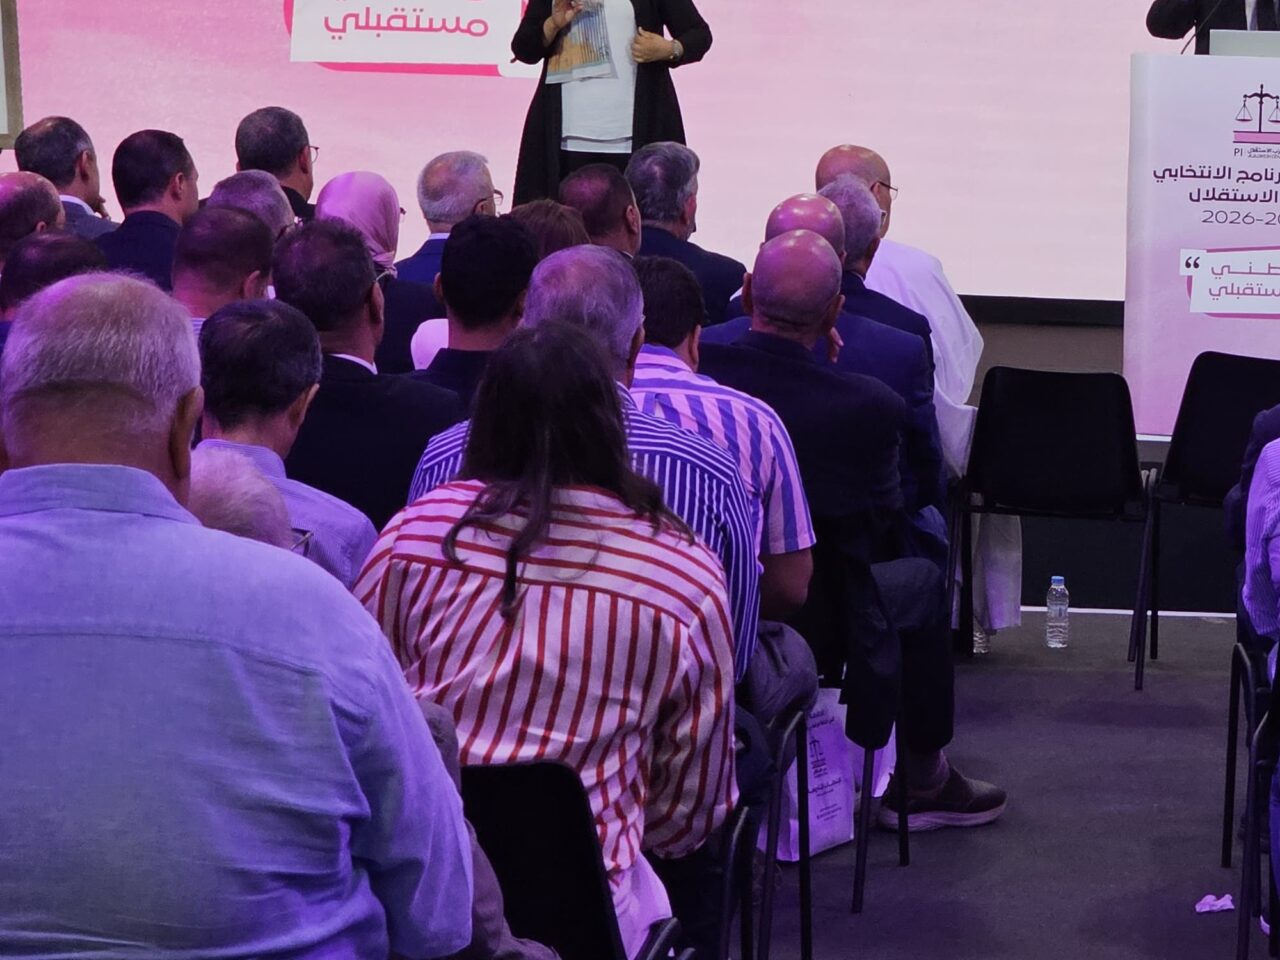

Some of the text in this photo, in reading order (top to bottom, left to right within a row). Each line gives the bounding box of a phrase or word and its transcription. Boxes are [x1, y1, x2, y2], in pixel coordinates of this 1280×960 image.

[324, 6, 489, 40] مستقبلي
[1234, 147, 1243, 157] PI
[1153, 165, 1231, 183] الانتخابي
[1189, 187, 1278, 203] الاستقلال
